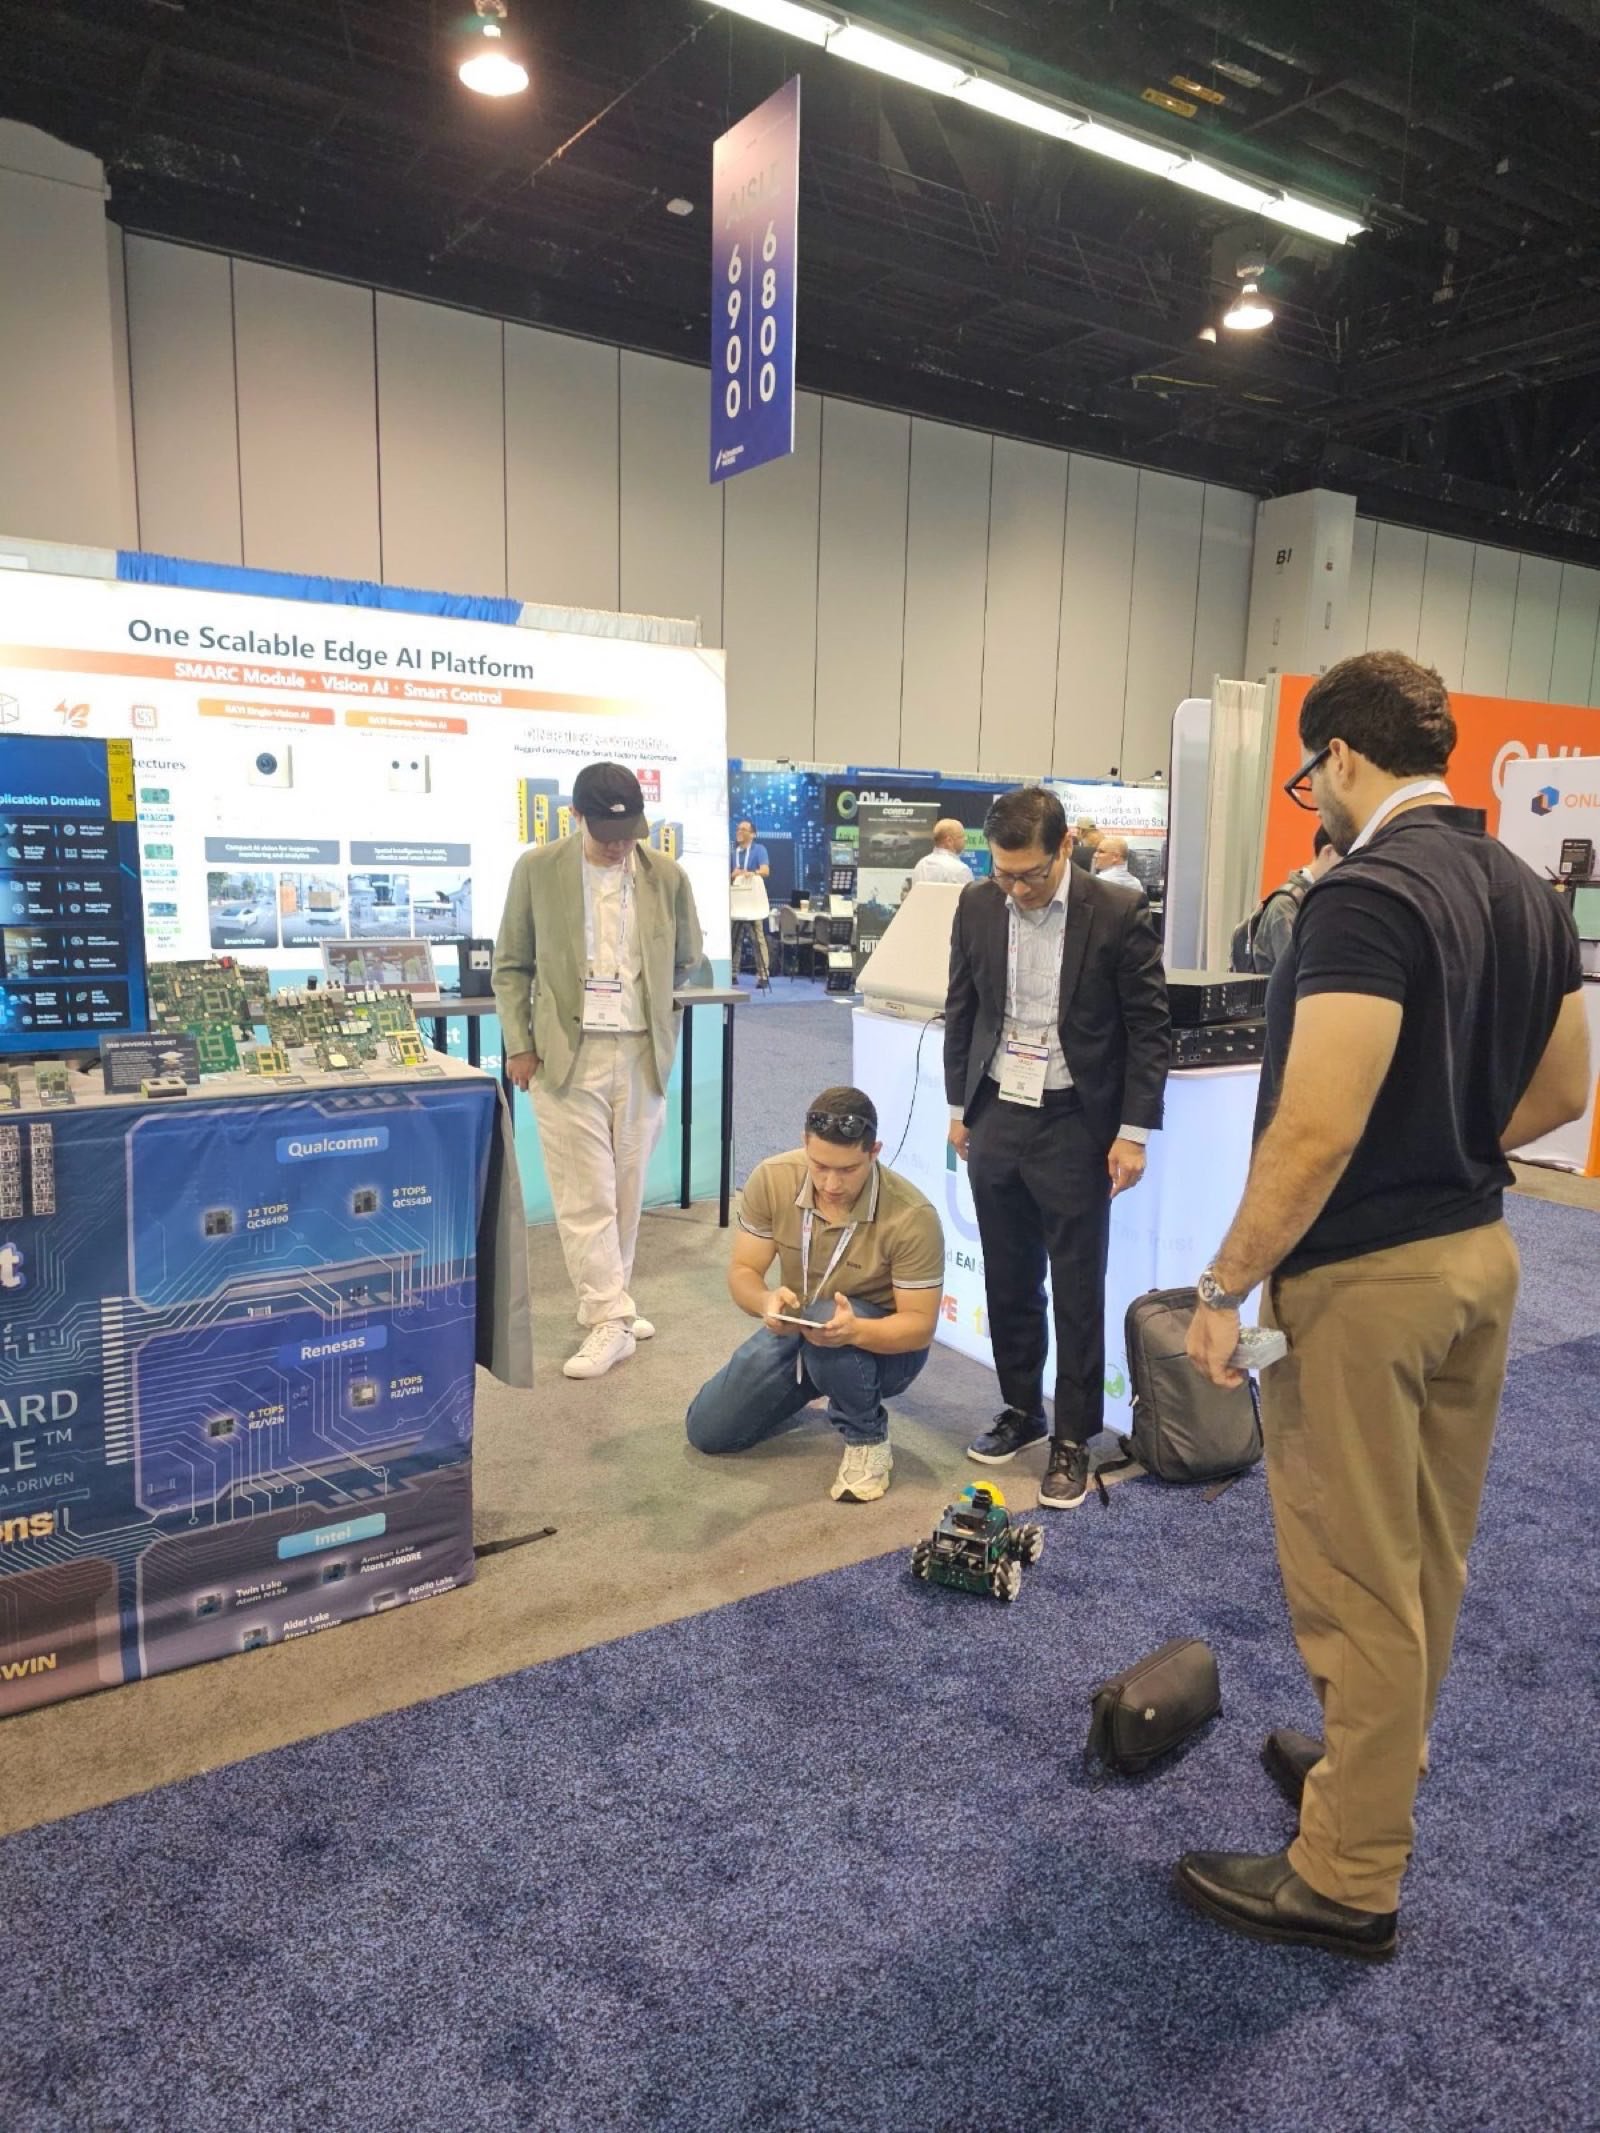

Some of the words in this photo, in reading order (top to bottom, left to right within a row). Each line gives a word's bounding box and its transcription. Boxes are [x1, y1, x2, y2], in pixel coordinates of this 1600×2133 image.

[128, 619, 190, 646] One
[200, 626, 315, 659] Scalable
[324, 640, 388, 669] Edge
[396, 648, 421, 669] AI
[432, 651, 534, 679] Platform
[175, 662, 239, 681] SMARC
[243, 668, 305, 689] Module
[321, 675, 369, 694] Vision
[372, 682, 389, 695] AI
[404, 683, 449, 700] Smart
[451, 688, 502, 705] Control
[51, 795, 101, 807] Domains
[288, 1135, 378, 1158] Qualcomm
[401, 1185, 426, 1196] TOPS
[248, 1208, 260, 1218] 12
[262, 1203, 289, 1216] TOPS
[247, 1215, 289, 1229] QCS6490
[301, 1336, 365, 1361] Renesas
[390, 1379, 397, 1389] 8
[399, 1375, 423, 1387] TOPS
[258, 1404, 284, 1416] TOPS
[315, 1527, 351, 1547] Intel
[236, 1586, 259, 1598] Twin
[261, 1580, 282, 1591] Lake
[408, 1581, 434, 1596] Apollo
[435, 1575, 454, 1586] Lake
[284, 1618, 308, 1632] Alder
[309, 1612, 330, 1623] Lake
[0, 1653, 56, 1681] WIN
